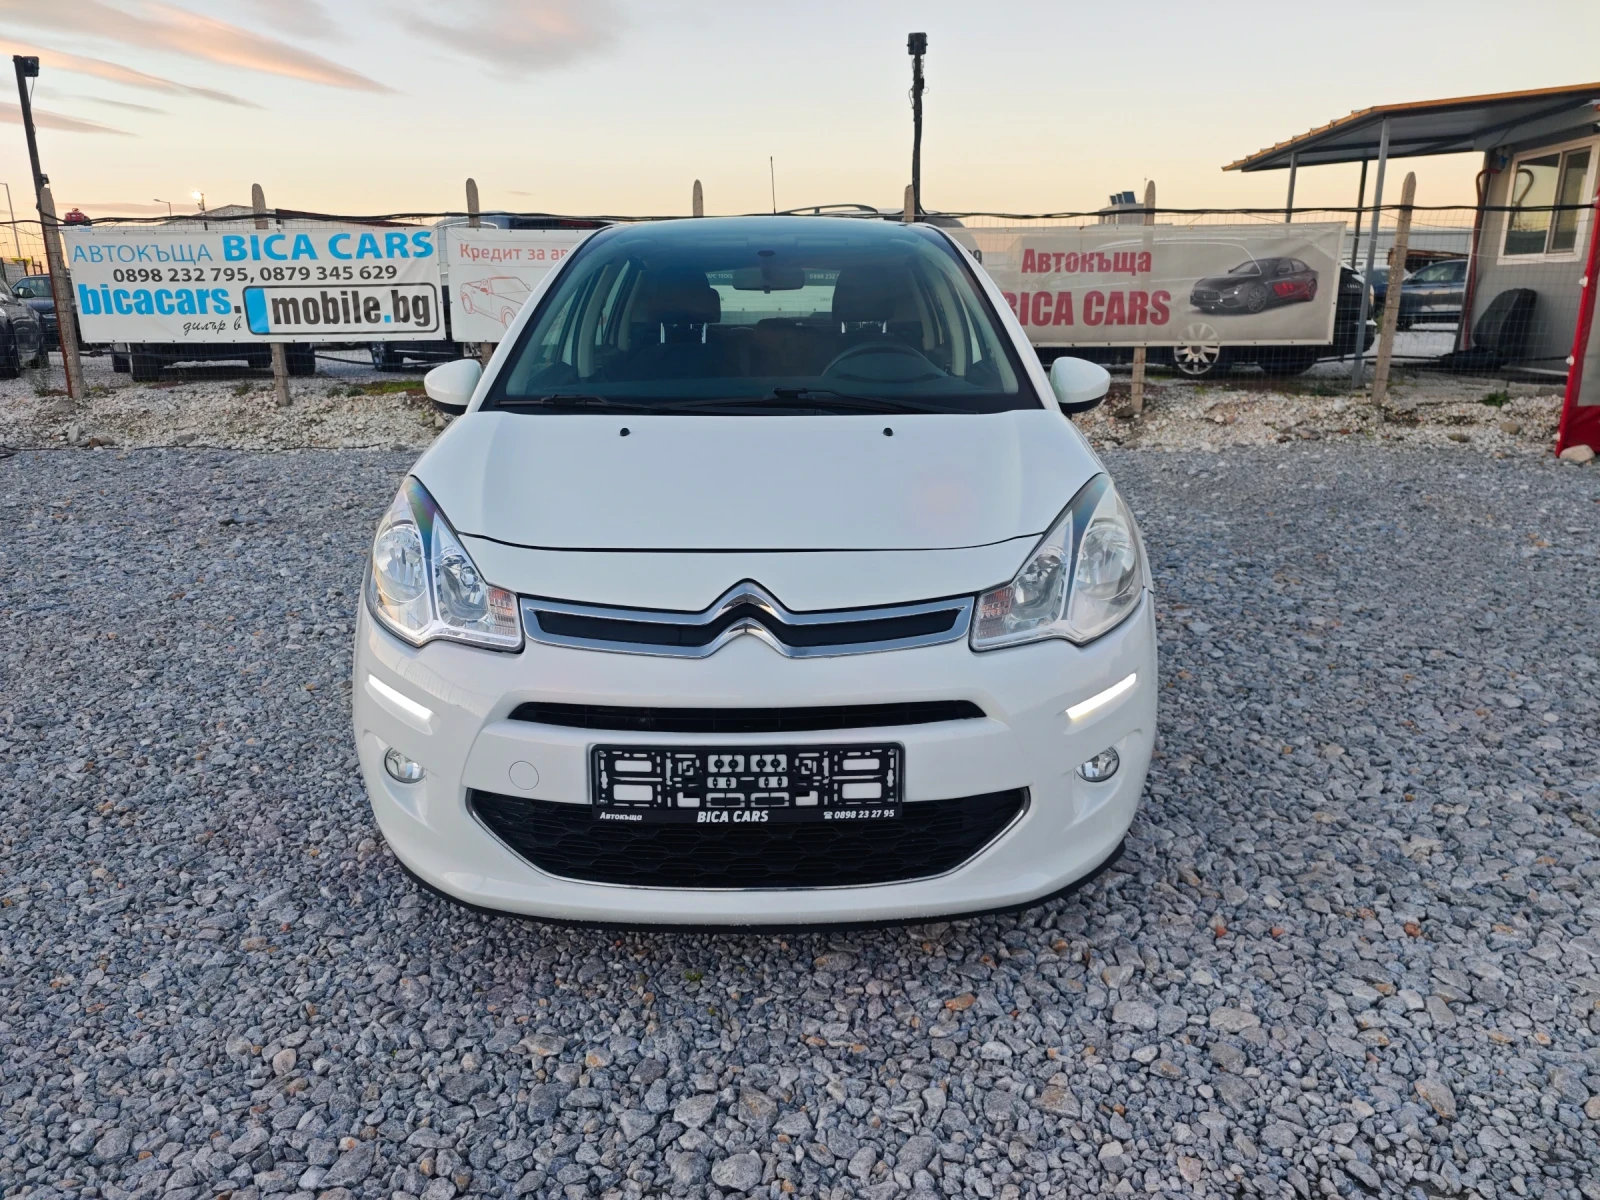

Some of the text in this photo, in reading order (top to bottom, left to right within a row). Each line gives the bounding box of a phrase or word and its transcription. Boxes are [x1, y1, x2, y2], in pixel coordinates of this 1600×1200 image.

[73, 231, 434, 265] АВТОКЪЩА BICA CARS
[460, 243, 522, 262] Кредит
[527, 249, 545, 261] за
[1021, 248, 1153, 276] Автокъща
[113, 265, 398, 284] 0898 232 795, 0879 345 629
[77, 283, 431, 327] bicacars. mobile.bg
[1083, 290, 1171, 326] CARS
[183, 319, 227, 335] дилър
[600, 811, 642, 821] Автокъща
[697, 810, 769, 823] BICA CARS
[834, 809, 895, 819] 0898 23 27 95
